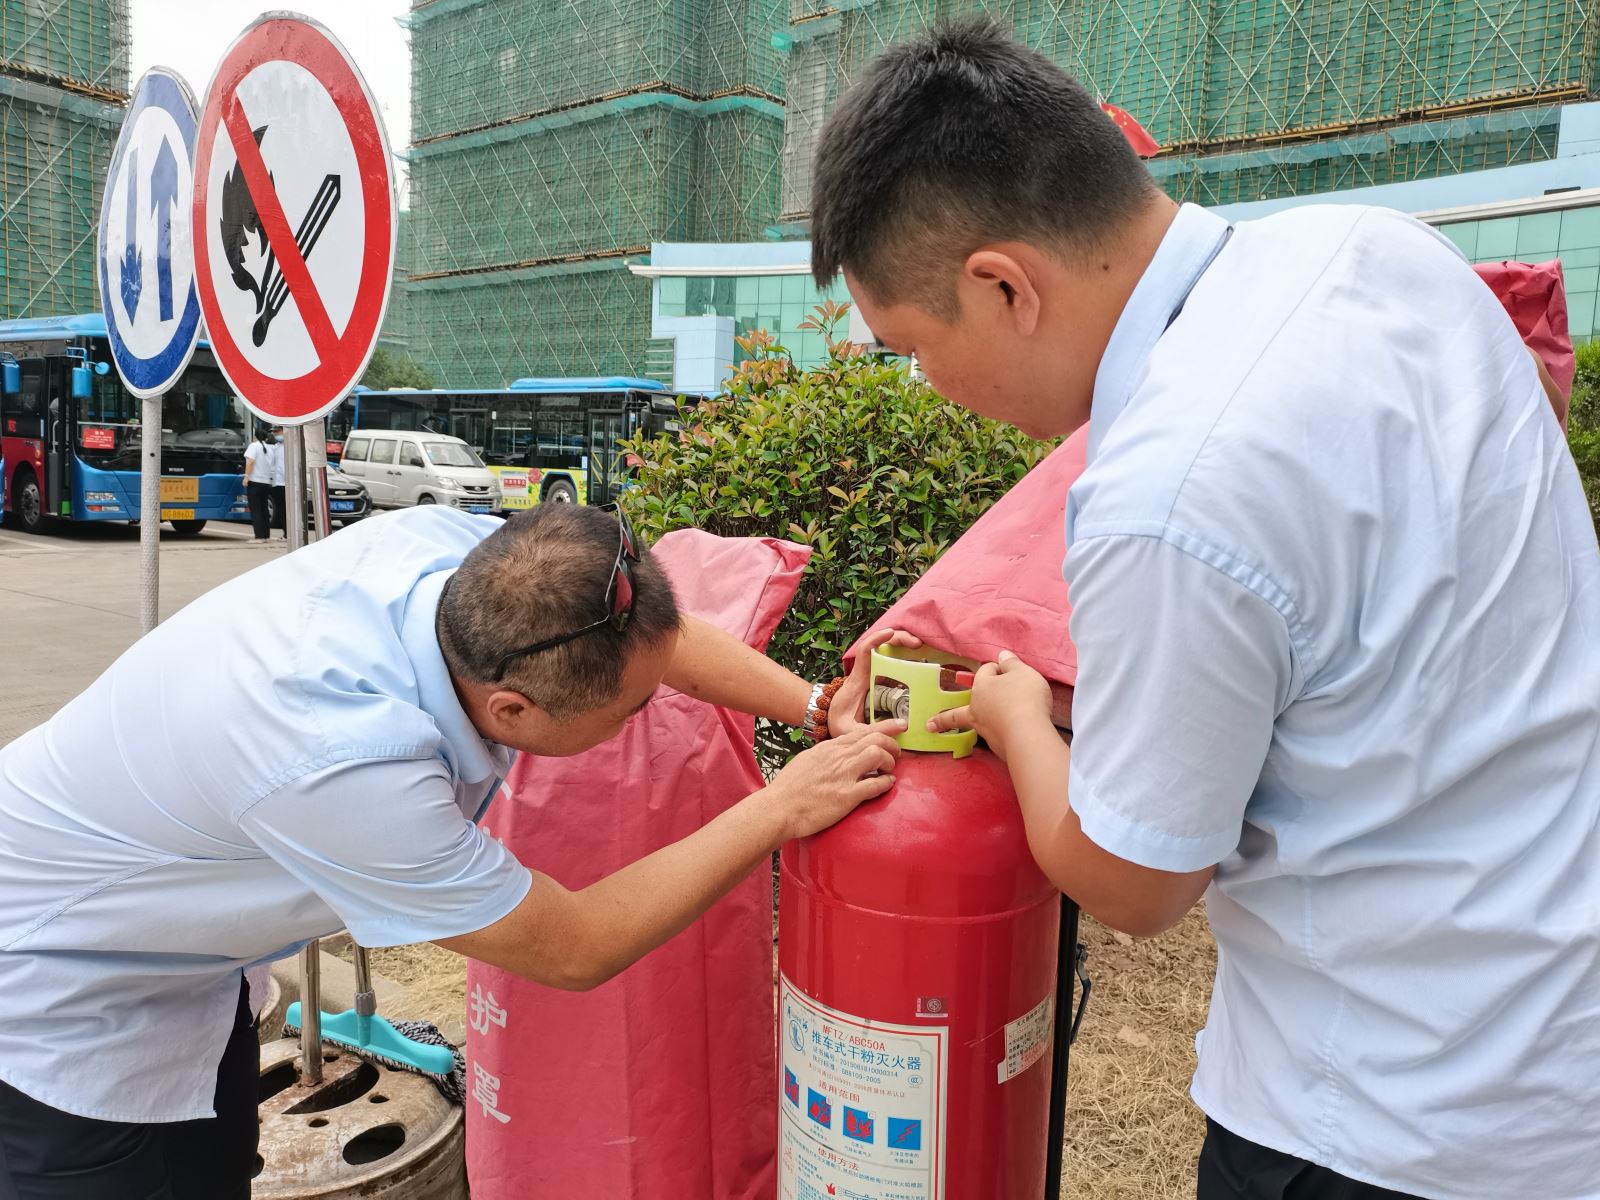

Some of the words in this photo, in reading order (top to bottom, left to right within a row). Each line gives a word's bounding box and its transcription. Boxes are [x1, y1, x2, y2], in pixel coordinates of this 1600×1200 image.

[812, 1030, 921, 1070] 推车式干粉灭火器
[822, 1024, 886, 1052] MFTZ/ABC50A
[818, 1147, 859, 1171] 使用方法
